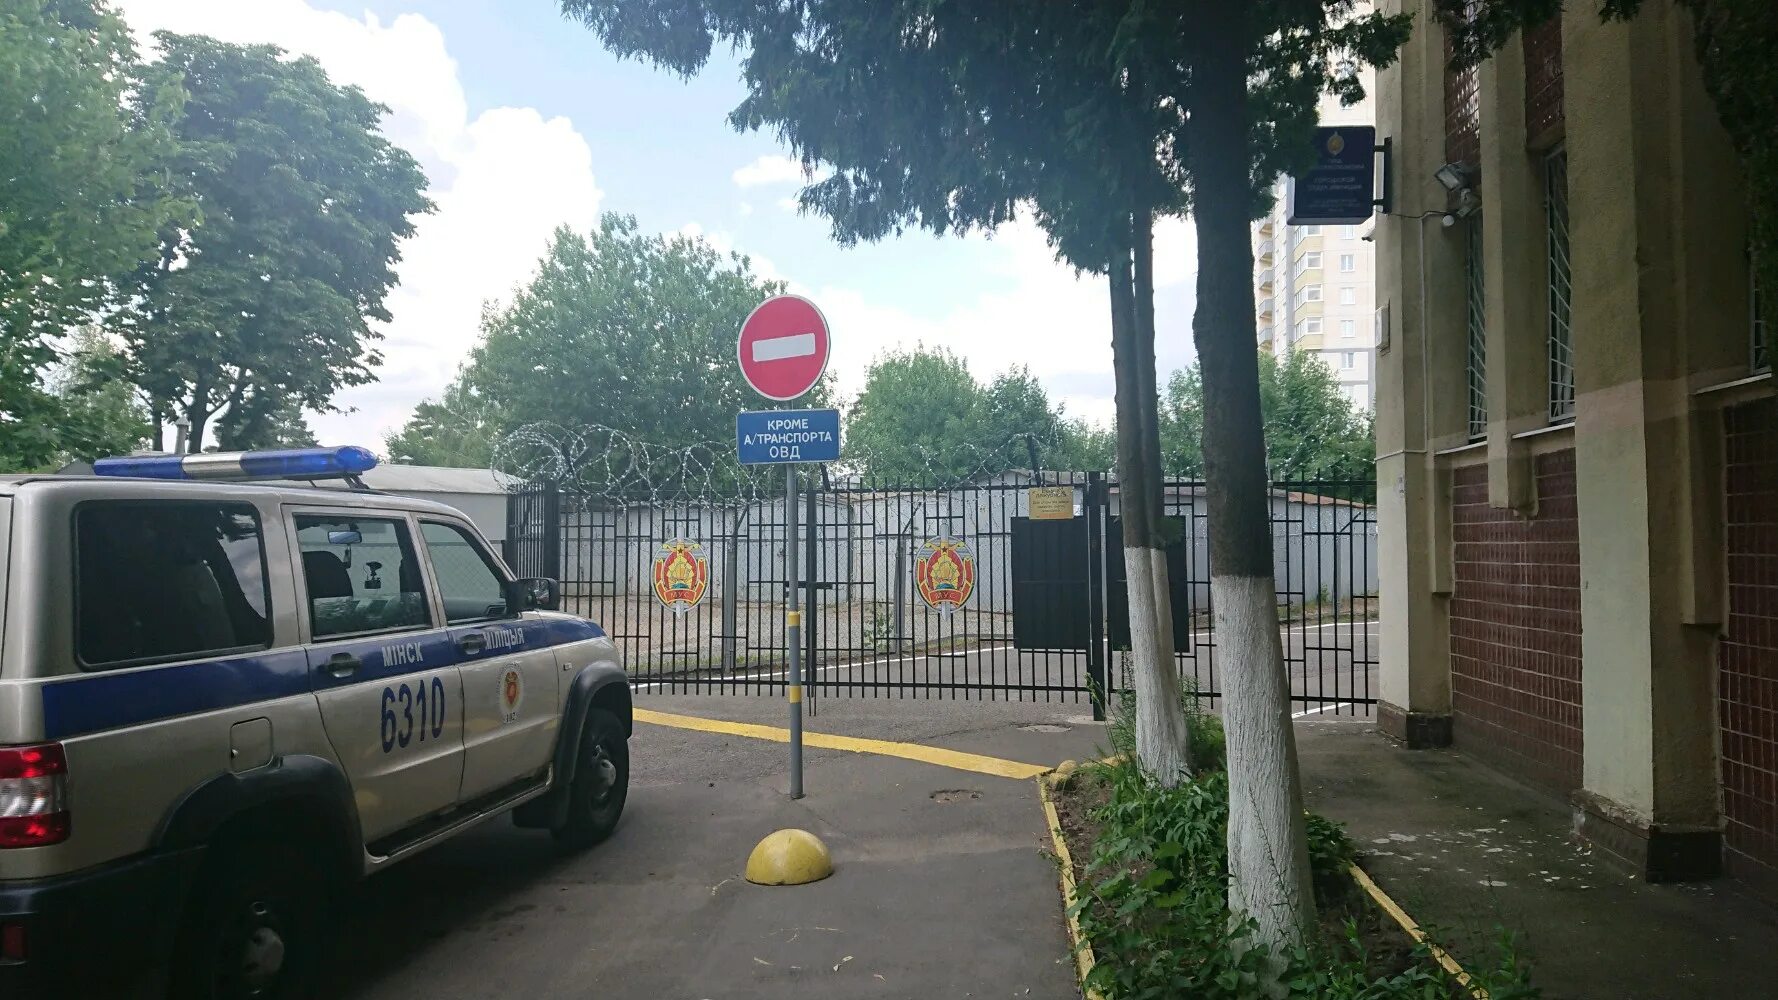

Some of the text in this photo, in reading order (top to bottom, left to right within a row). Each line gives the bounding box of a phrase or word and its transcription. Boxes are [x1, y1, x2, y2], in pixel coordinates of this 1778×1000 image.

[767, 419, 809, 431] КРОМЕ
[744, 431, 833, 446] А/ТРАНСПОРТА
[769, 445, 801, 460] ОВД
[381, 641, 424, 667] МІНСК
[381, 676, 445, 753] 6310
